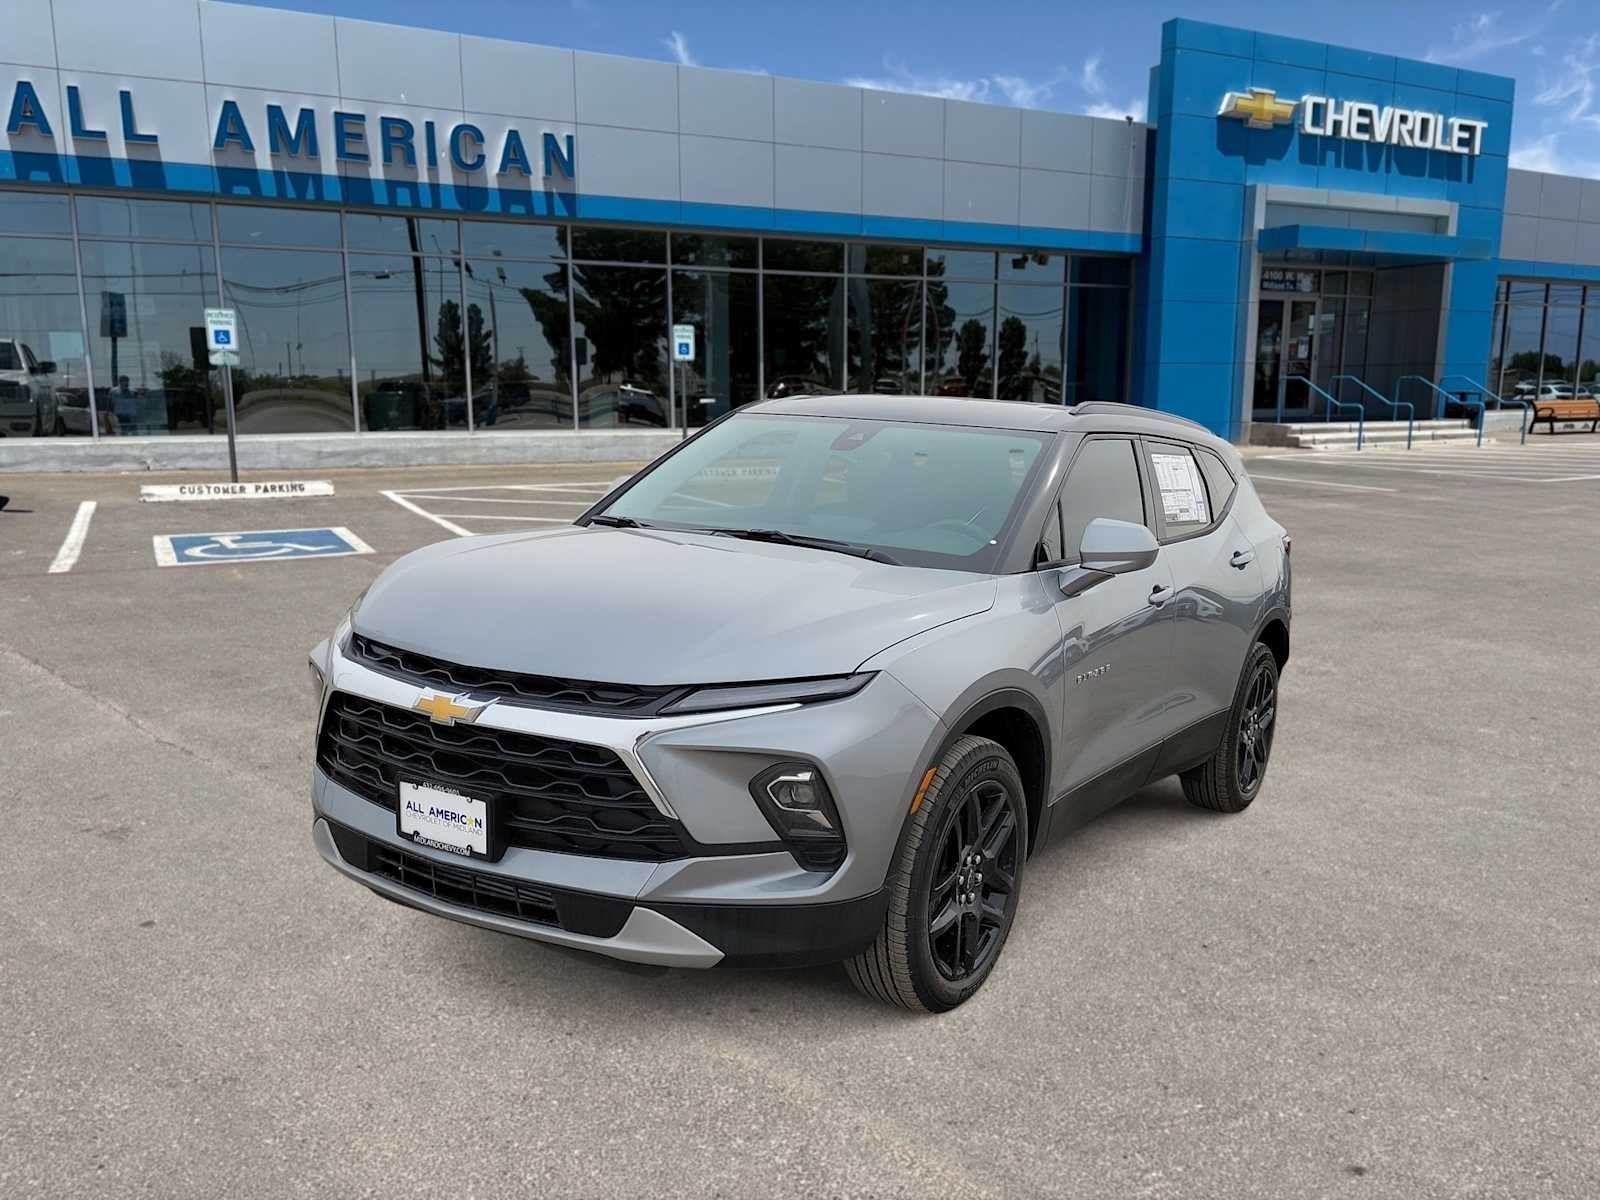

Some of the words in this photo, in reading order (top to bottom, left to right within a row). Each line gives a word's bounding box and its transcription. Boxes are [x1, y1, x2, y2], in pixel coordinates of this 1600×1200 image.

[6, 79, 160, 144] ALL
[212, 99, 577, 179] AMERICAN
[1301, 94, 1489, 157] CHEVROLET
[179, 485, 246, 495] CUSTOMER
[254, 483, 306, 493] PARKING
[406, 800, 424, 814] ALL
